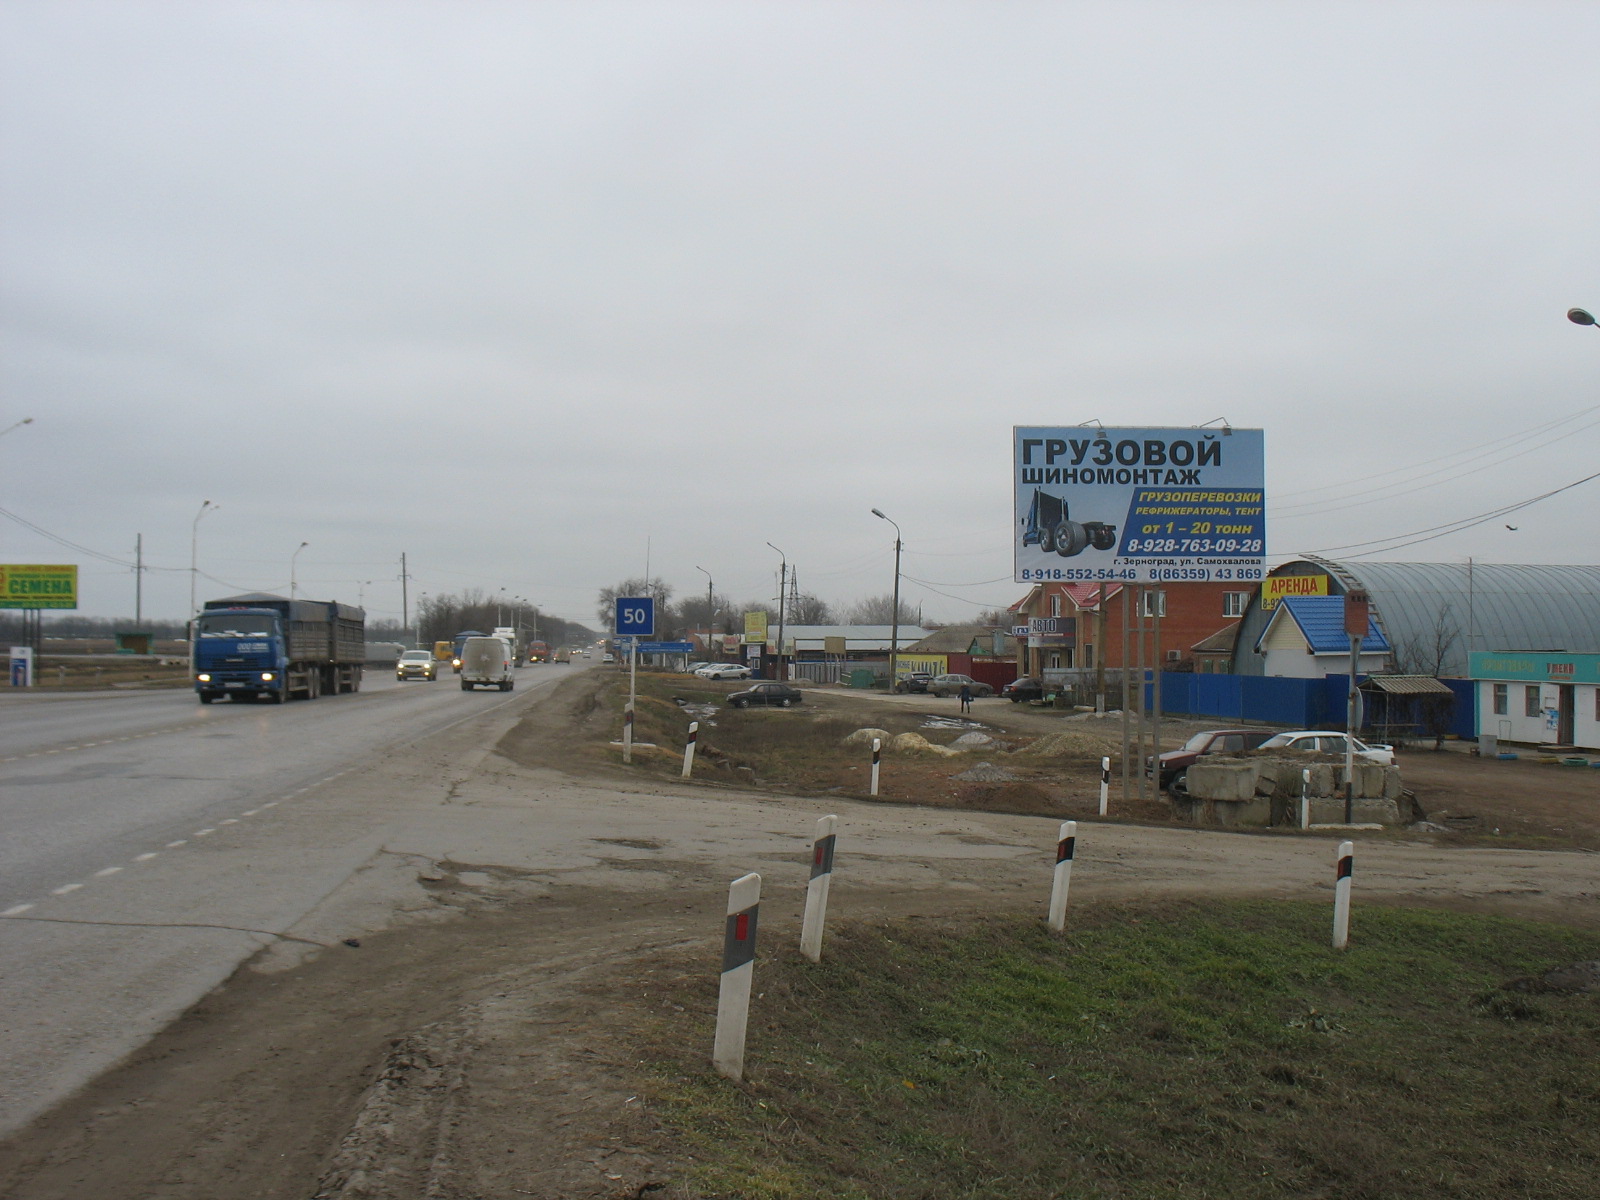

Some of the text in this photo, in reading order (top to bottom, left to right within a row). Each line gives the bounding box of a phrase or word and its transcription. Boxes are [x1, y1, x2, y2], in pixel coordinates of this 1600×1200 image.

[1022, 435, 1221, 467] ГРУЗОВОЙ
[1022, 468, 1201, 485] ШИНОМОНТАЖ
[1138, 492, 1261, 502] ГРУЗОПЕРЕВОЗКИ
[1136, 507, 1261, 516] РЕФРИЖЕРАТОРЫ, ТЕНТ
[1142, 524, 1160, 534] от
[1165, 522, 1174, 534] 1
[1190, 522, 1211, 534] 20
[1215, 525, 1252, 534] тонн
[1128, 539, 1261, 552] 8-928-763-09-28
[1123, 558, 1177, 566] Зерноград,
[1180, 558, 1194, 567] ул.
[1197, 557, 1261, 565] Самохвалова
[1022, 568, 1262, 581] 8-918-552-54-46 8(86359) 43 869
[9, 580, 72, 594] СЕМЕНА
[1271, 578, 1318, 595] АРЕНДА
[624, 608, 645, 624] 50
[1032, 619, 1056, 632] АВТО
